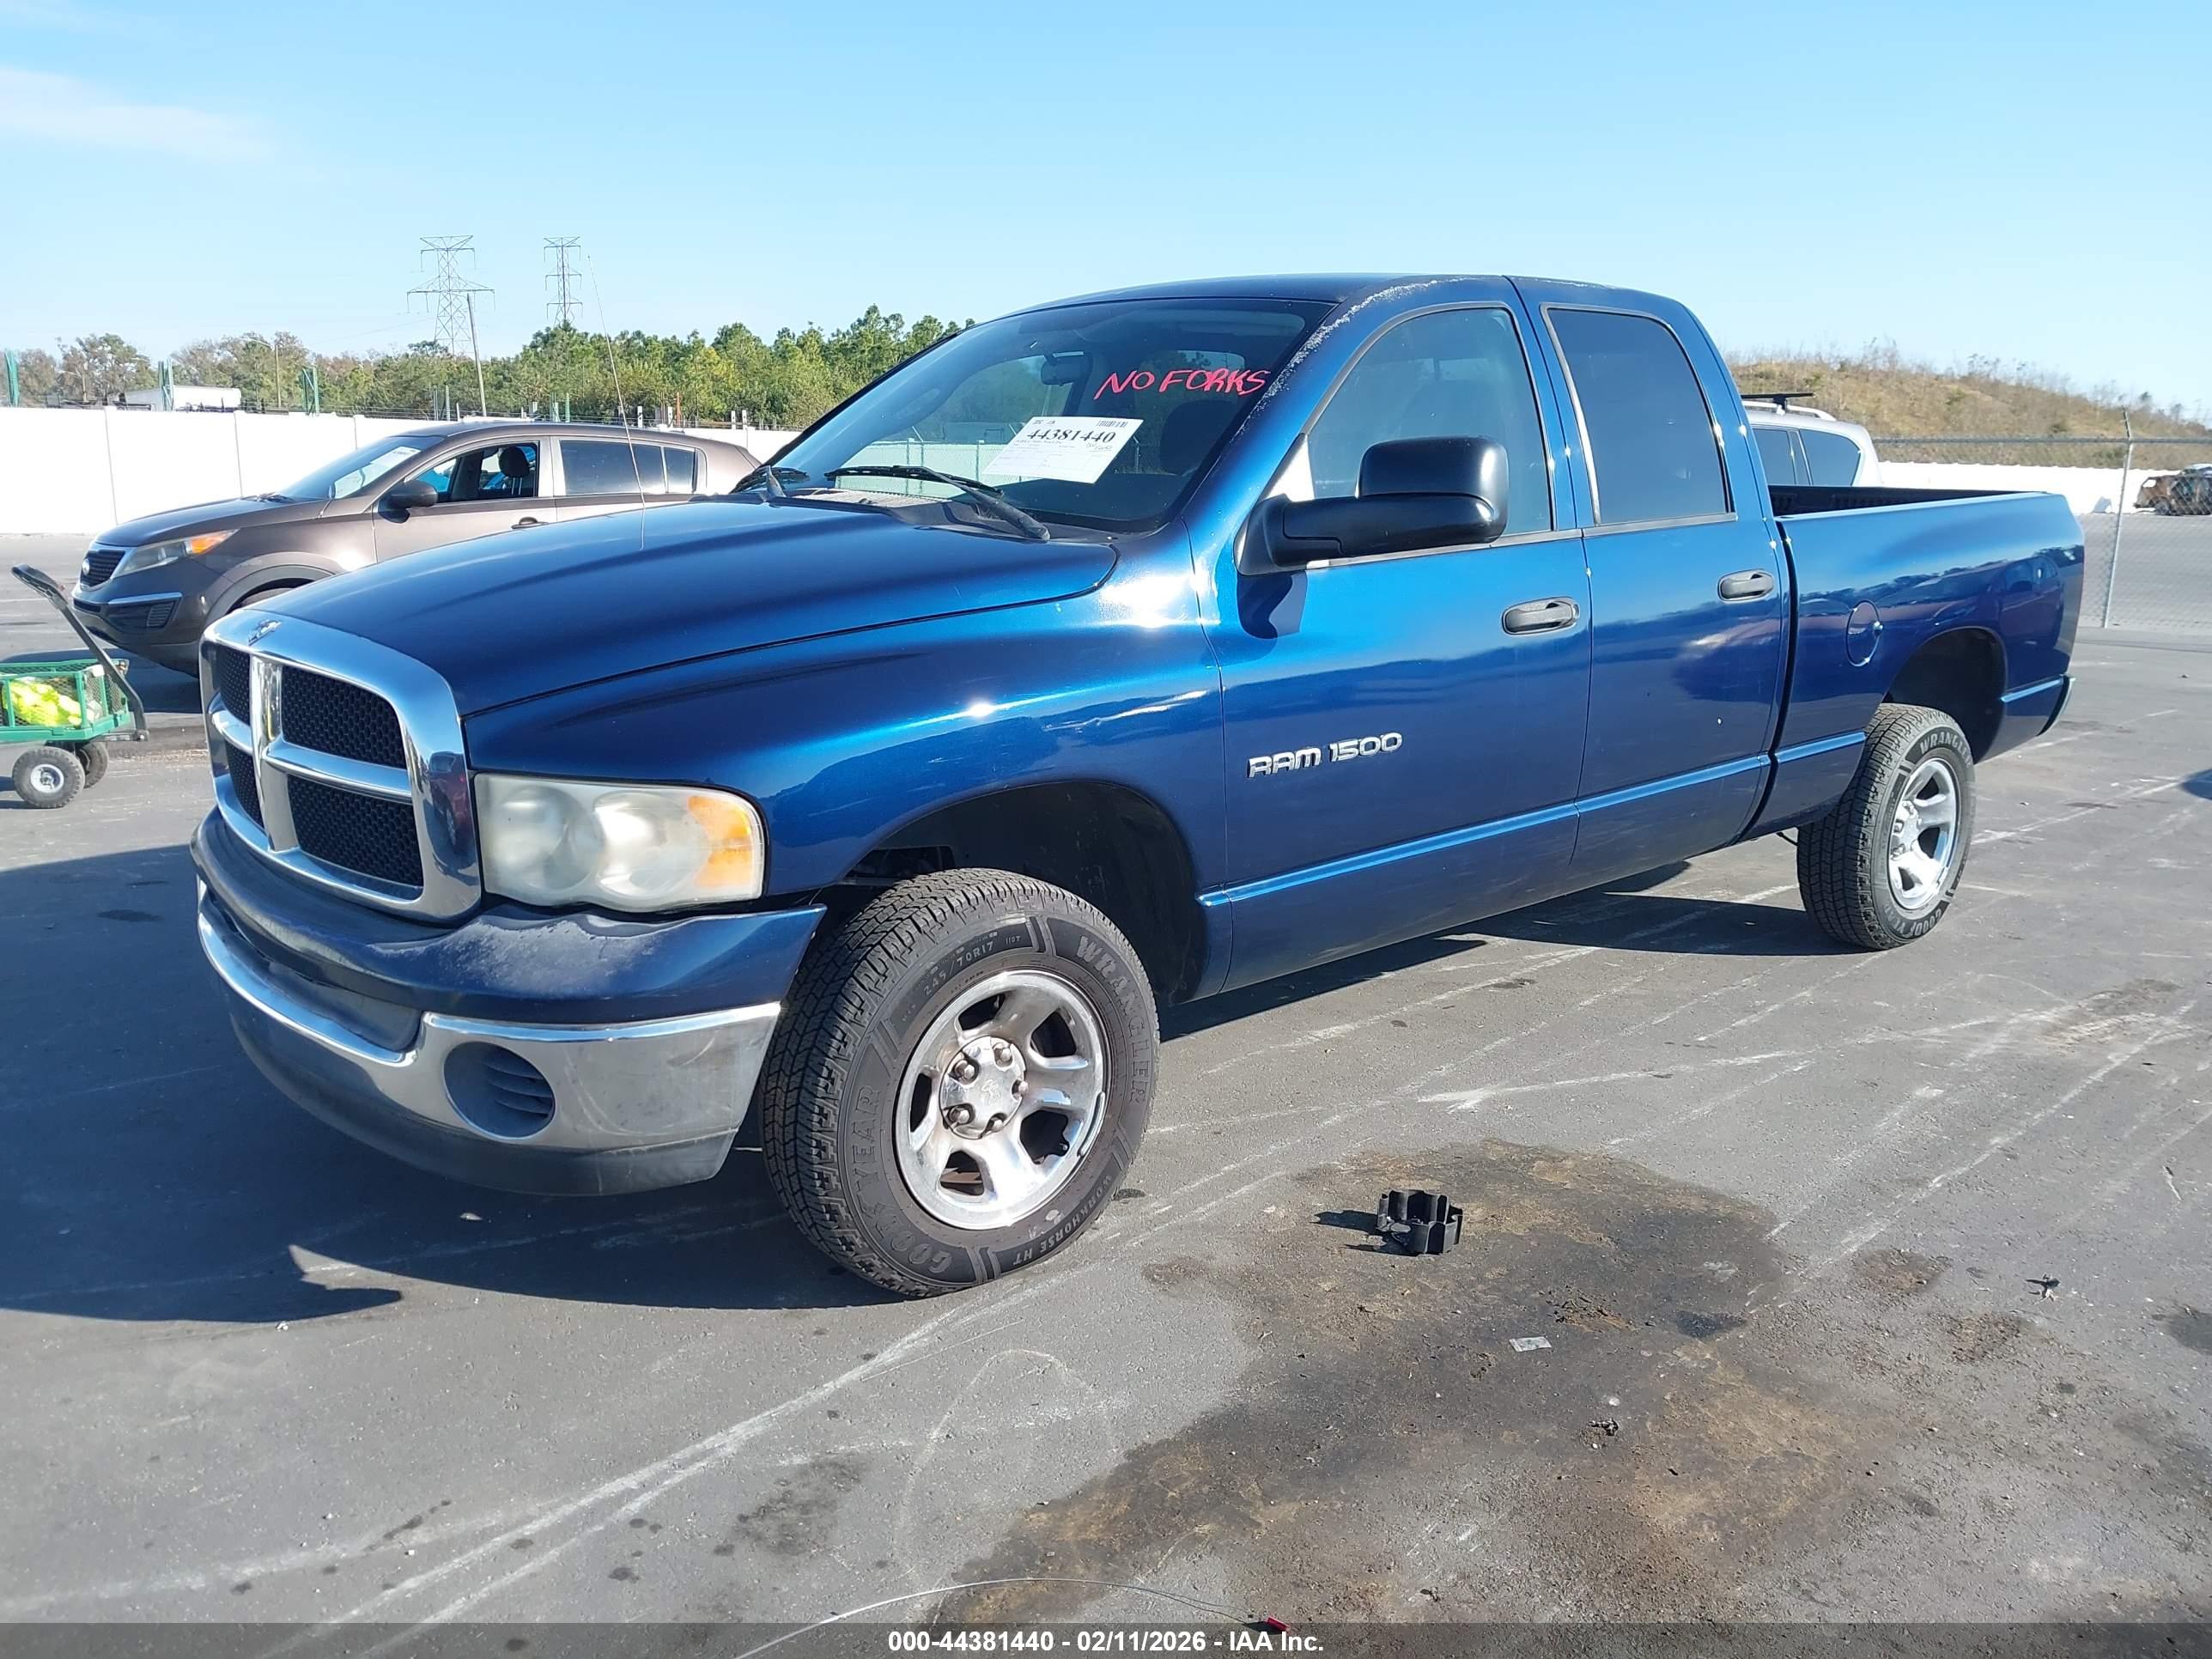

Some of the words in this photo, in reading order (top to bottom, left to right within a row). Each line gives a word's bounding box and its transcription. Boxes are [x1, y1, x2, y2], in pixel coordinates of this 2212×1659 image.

[1092, 370, 1155, 400] NO
[1158, 368, 1272, 396] FORKS
[1027, 428, 1116, 443] 44381440
[1247, 747, 1322, 779] RAM
[1329, 732, 1403, 763] 1500
[923, 940, 994, 996] 245/70R17
[1076, 936, 1151, 1103] WRANGLER
[1040, 1175, 1112, 1253] WORKHORSE
[1012, 1248, 1033, 1265] HT
